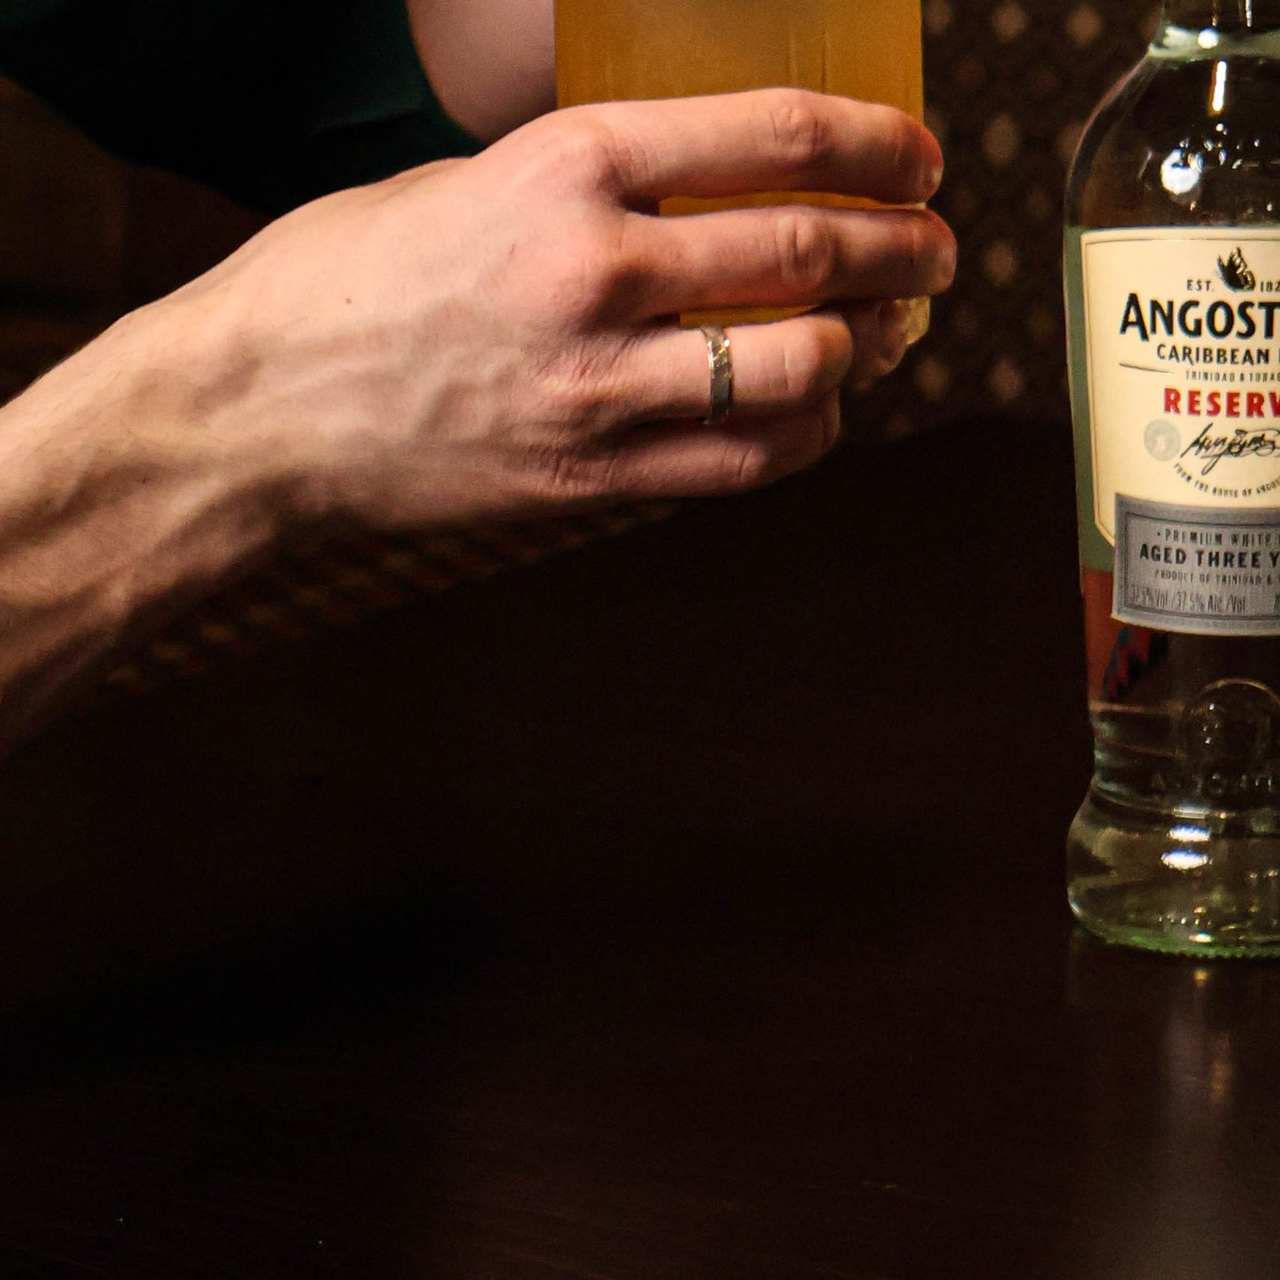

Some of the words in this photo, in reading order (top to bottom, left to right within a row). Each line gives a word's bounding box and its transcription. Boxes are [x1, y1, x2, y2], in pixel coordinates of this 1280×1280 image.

[1187, 279, 1214, 292] EST.
[1157, 344, 1269, 366] CARIBBEAN
[1186, 371, 1235, 382] TRINIDAD
[1140, 543, 1187, 565] AGED
[1195, 550, 1261, 568] THREE
